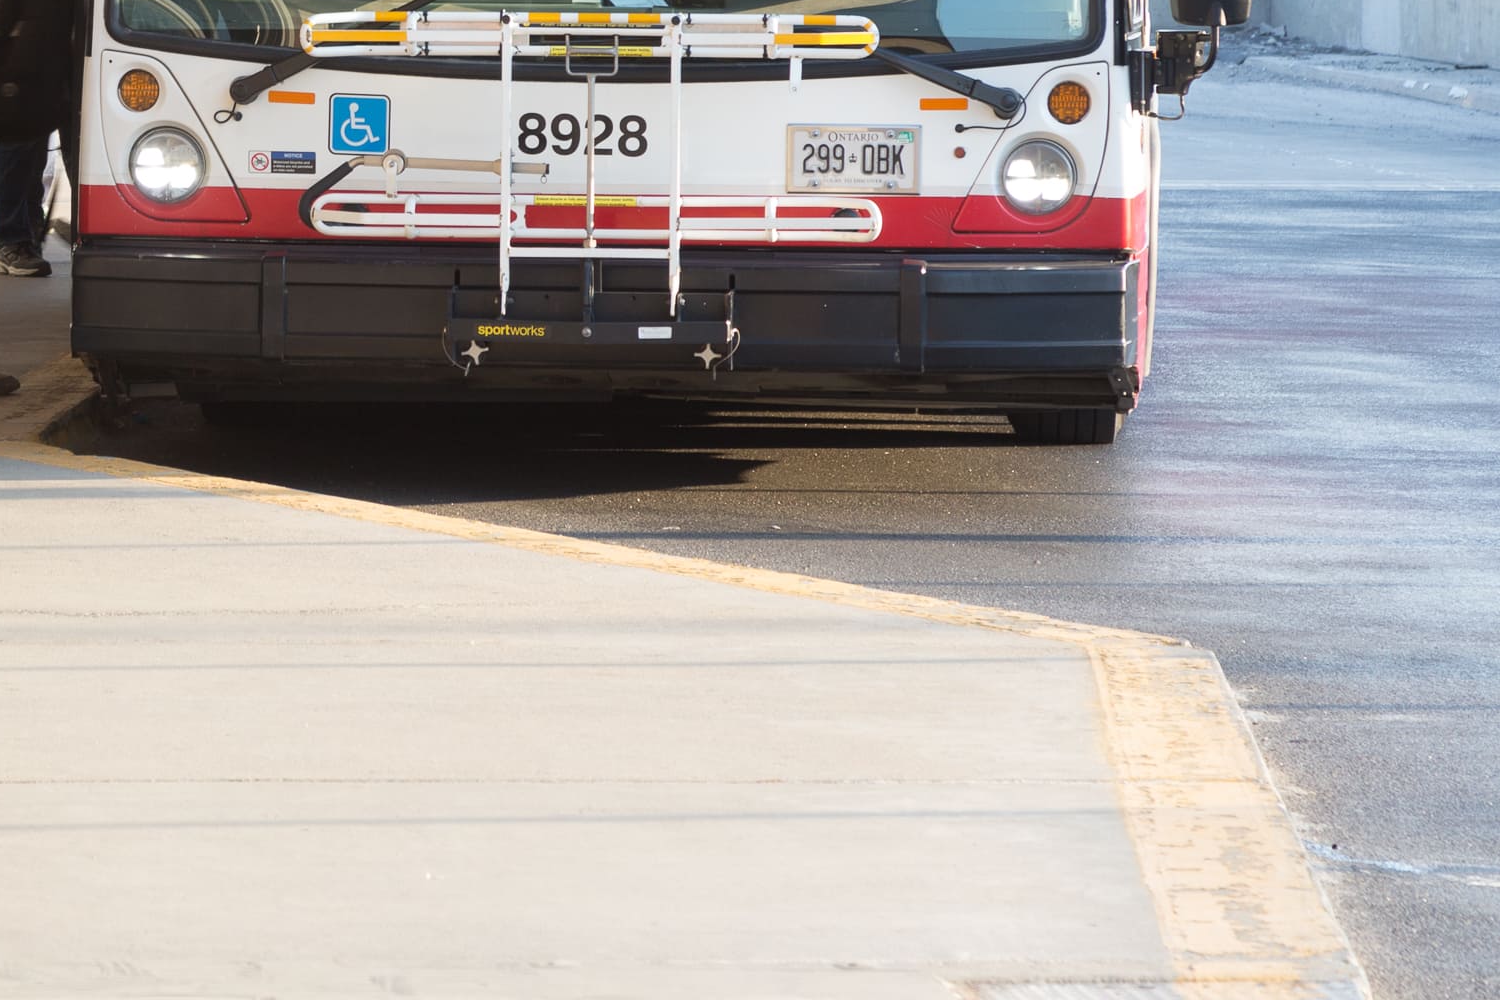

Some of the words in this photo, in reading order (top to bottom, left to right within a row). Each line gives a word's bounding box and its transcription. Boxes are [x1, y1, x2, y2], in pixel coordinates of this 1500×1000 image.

[518, 112, 648, 157] 8928
[828, 131, 879, 142] ONTARIO
[802, 143, 845, 174] 299
[477, 324, 545, 337] sportworks
